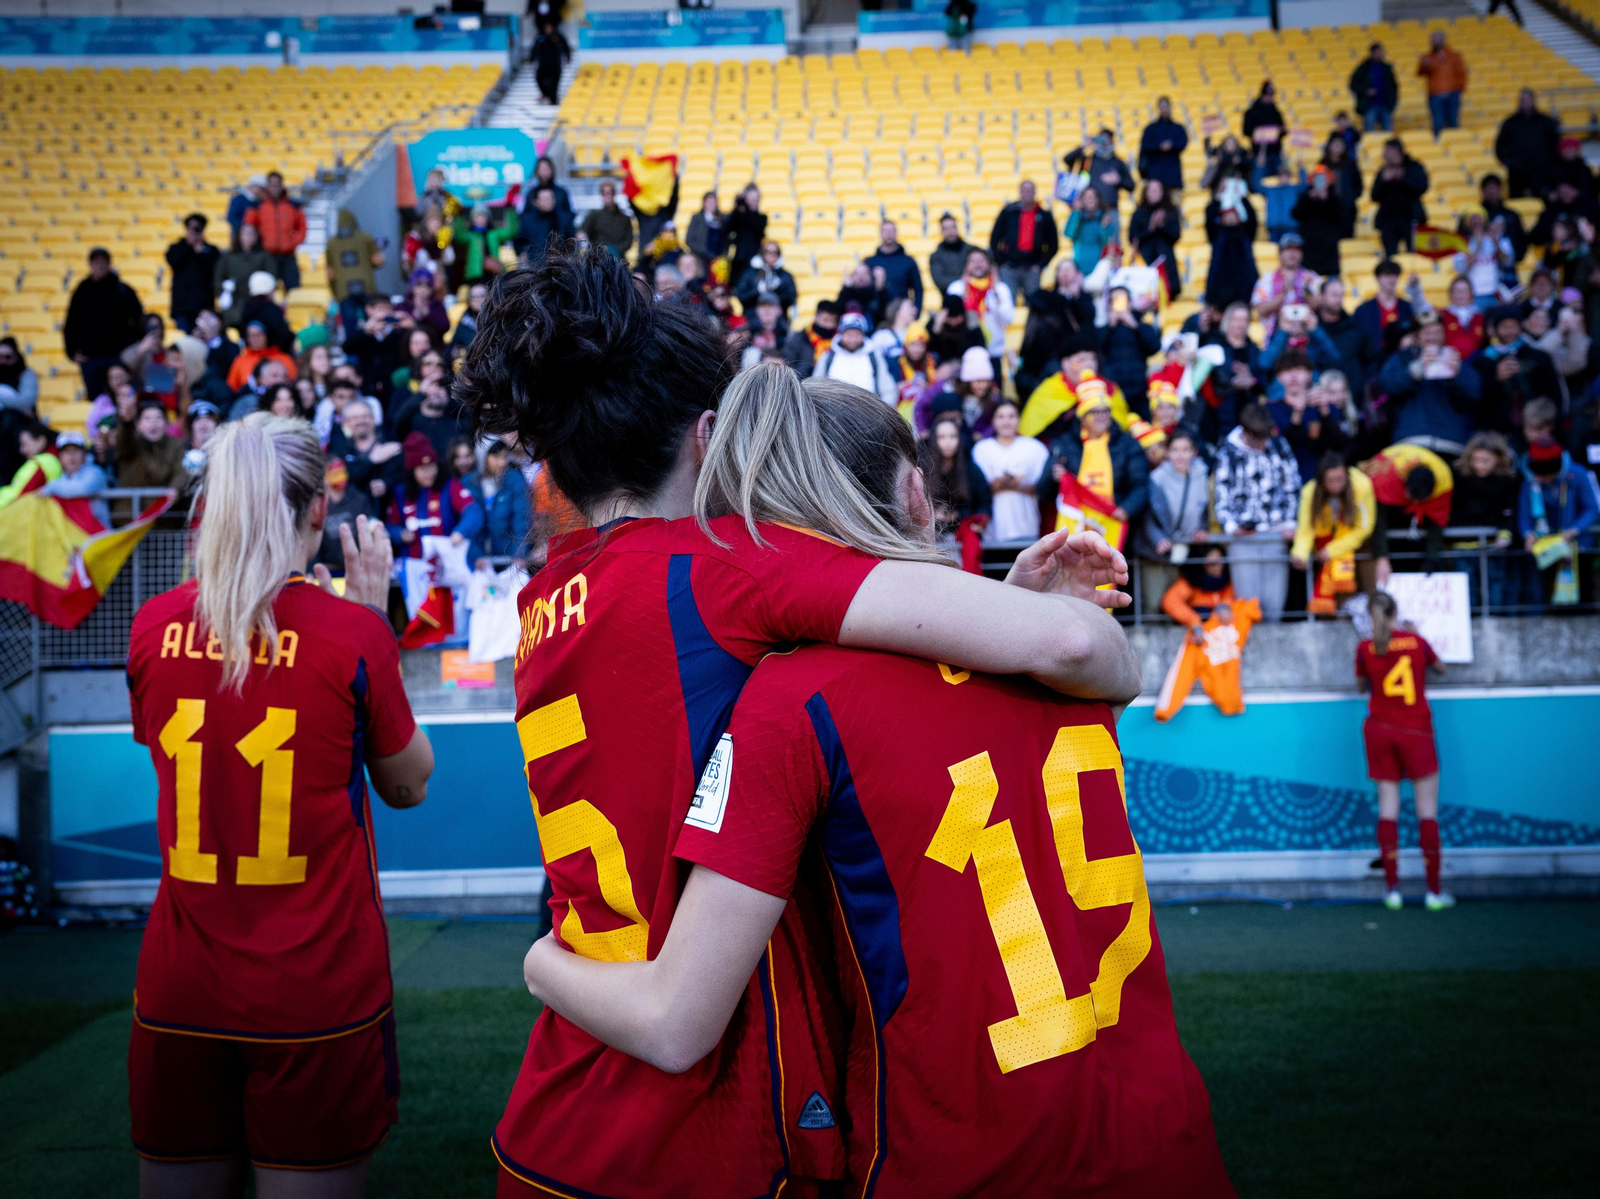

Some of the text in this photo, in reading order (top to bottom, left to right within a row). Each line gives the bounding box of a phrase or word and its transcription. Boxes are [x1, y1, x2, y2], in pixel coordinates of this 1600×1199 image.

[160, 621, 299, 668] ALEIA
[1382, 654, 1417, 706] 4
[158, 698, 308, 885] 11
[516, 693, 650, 962] 5
[924, 723, 1152, 1074] 19
